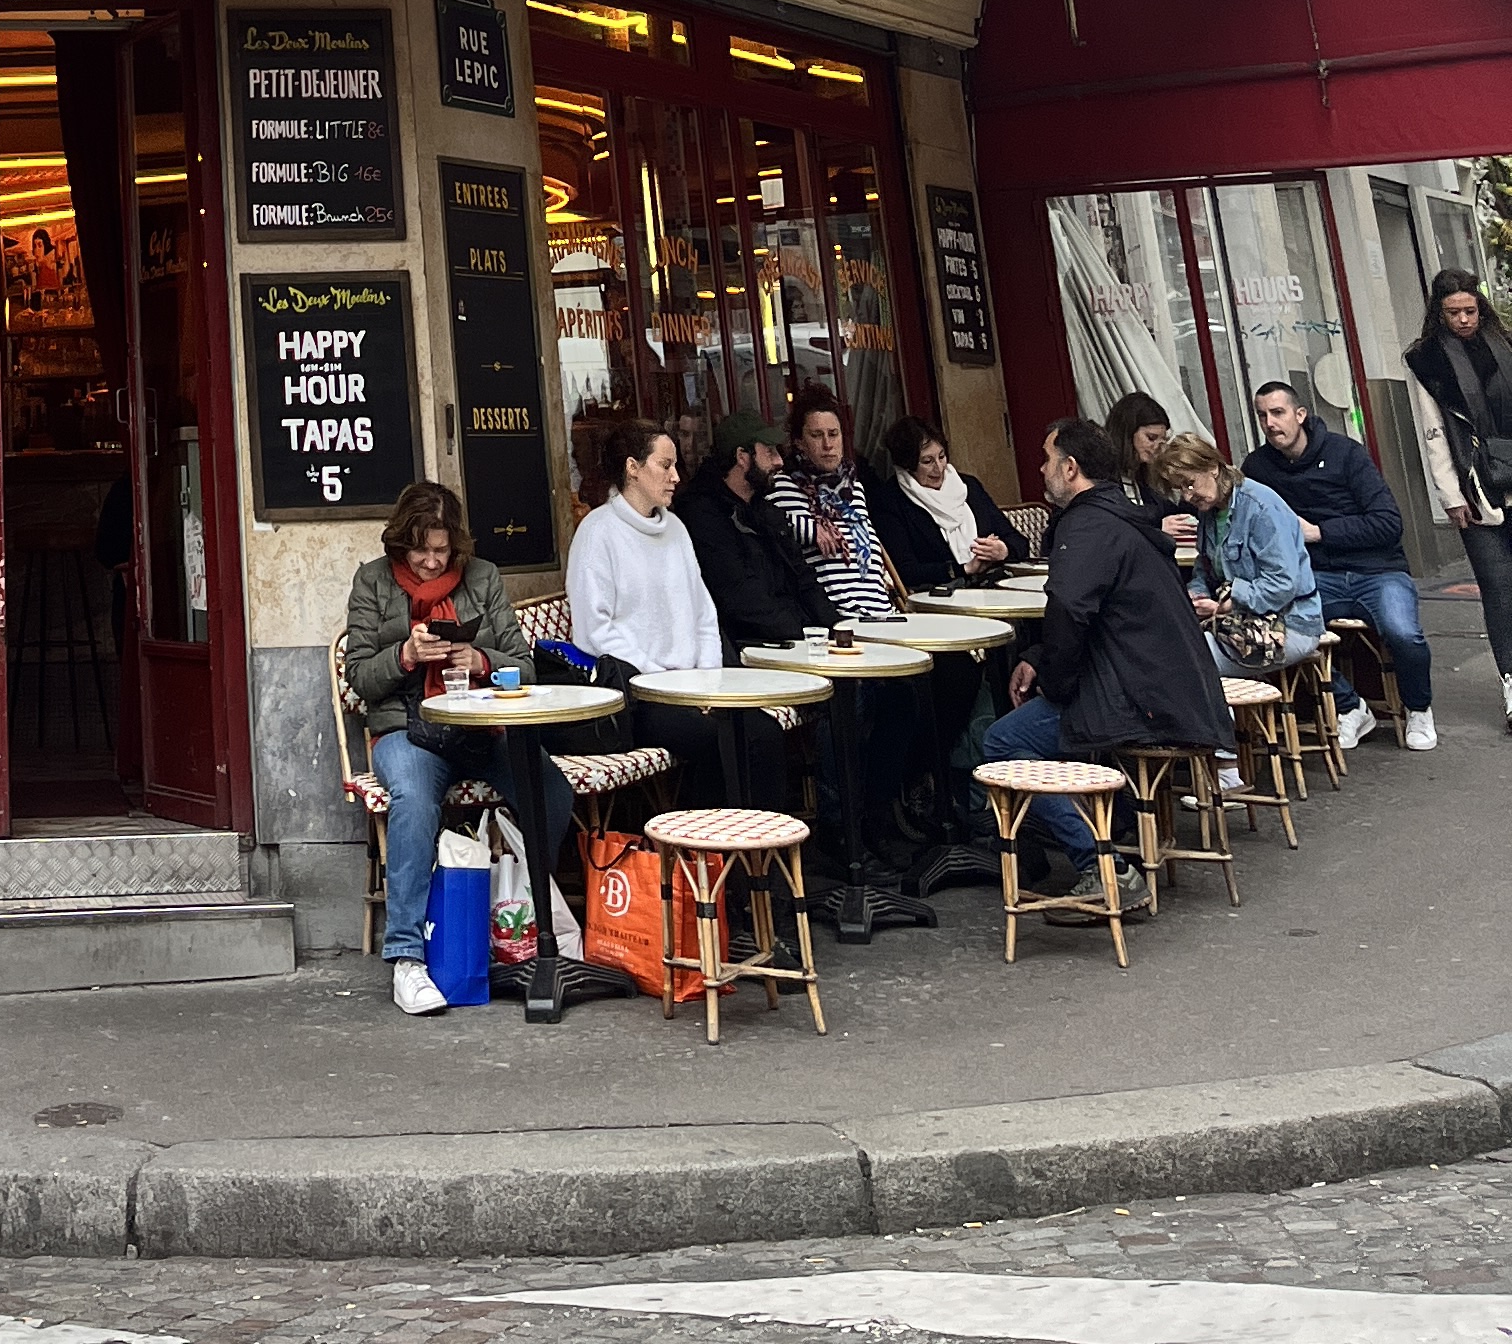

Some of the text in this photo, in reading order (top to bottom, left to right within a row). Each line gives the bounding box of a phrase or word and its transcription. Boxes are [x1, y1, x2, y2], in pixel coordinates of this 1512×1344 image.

[458, 26, 489, 55] RUE
[455, 57, 499, 89] LEPIC
[316, 120, 367, 140] LITTLE
[313, 161, 349, 183] BIG
[454, 181, 510, 210] ENTREES
[469, 248, 507, 274] PLATS
[262, 286, 387, 313] Les Deux Moulins
[278, 329, 367, 360] HAPPY
[284, 373, 366, 405] HOUR
[473, 407, 530, 431] DESSERTS
[281, 417, 374, 452] TAPAS
